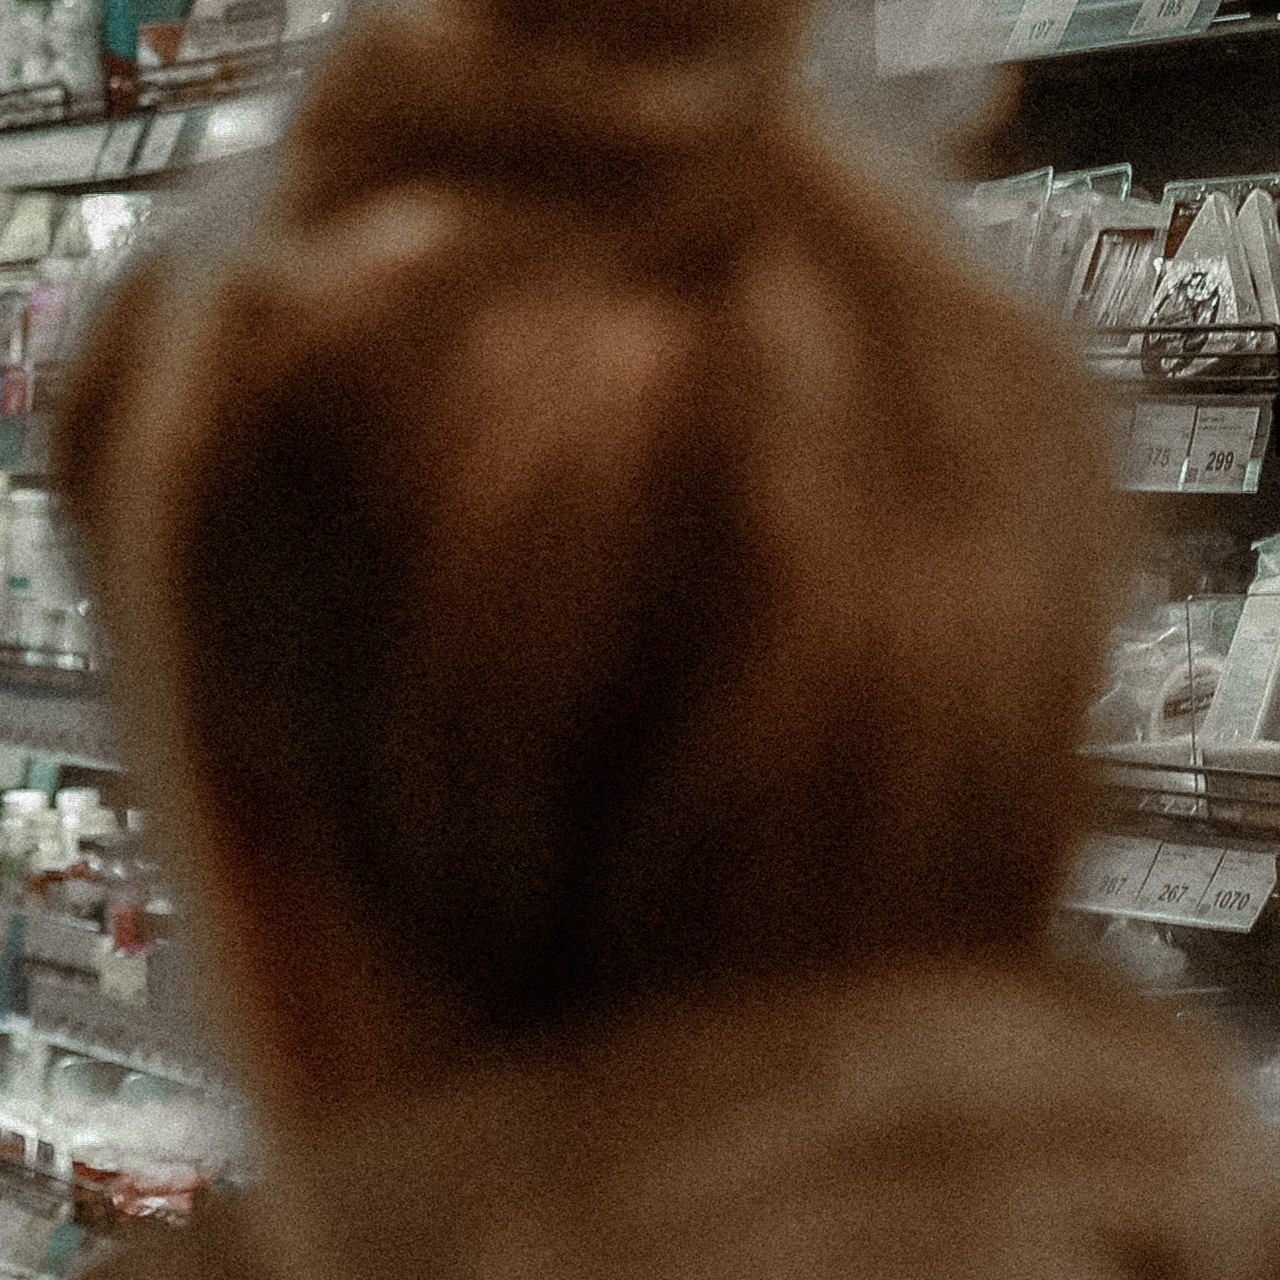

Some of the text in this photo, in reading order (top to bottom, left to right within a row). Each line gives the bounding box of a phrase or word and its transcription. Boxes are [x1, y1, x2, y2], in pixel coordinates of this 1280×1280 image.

[1205, 450, 1235, 472] 299
[1157, 883, 1189, 904] 267
[1213, 889, 1251, 911] 1070
